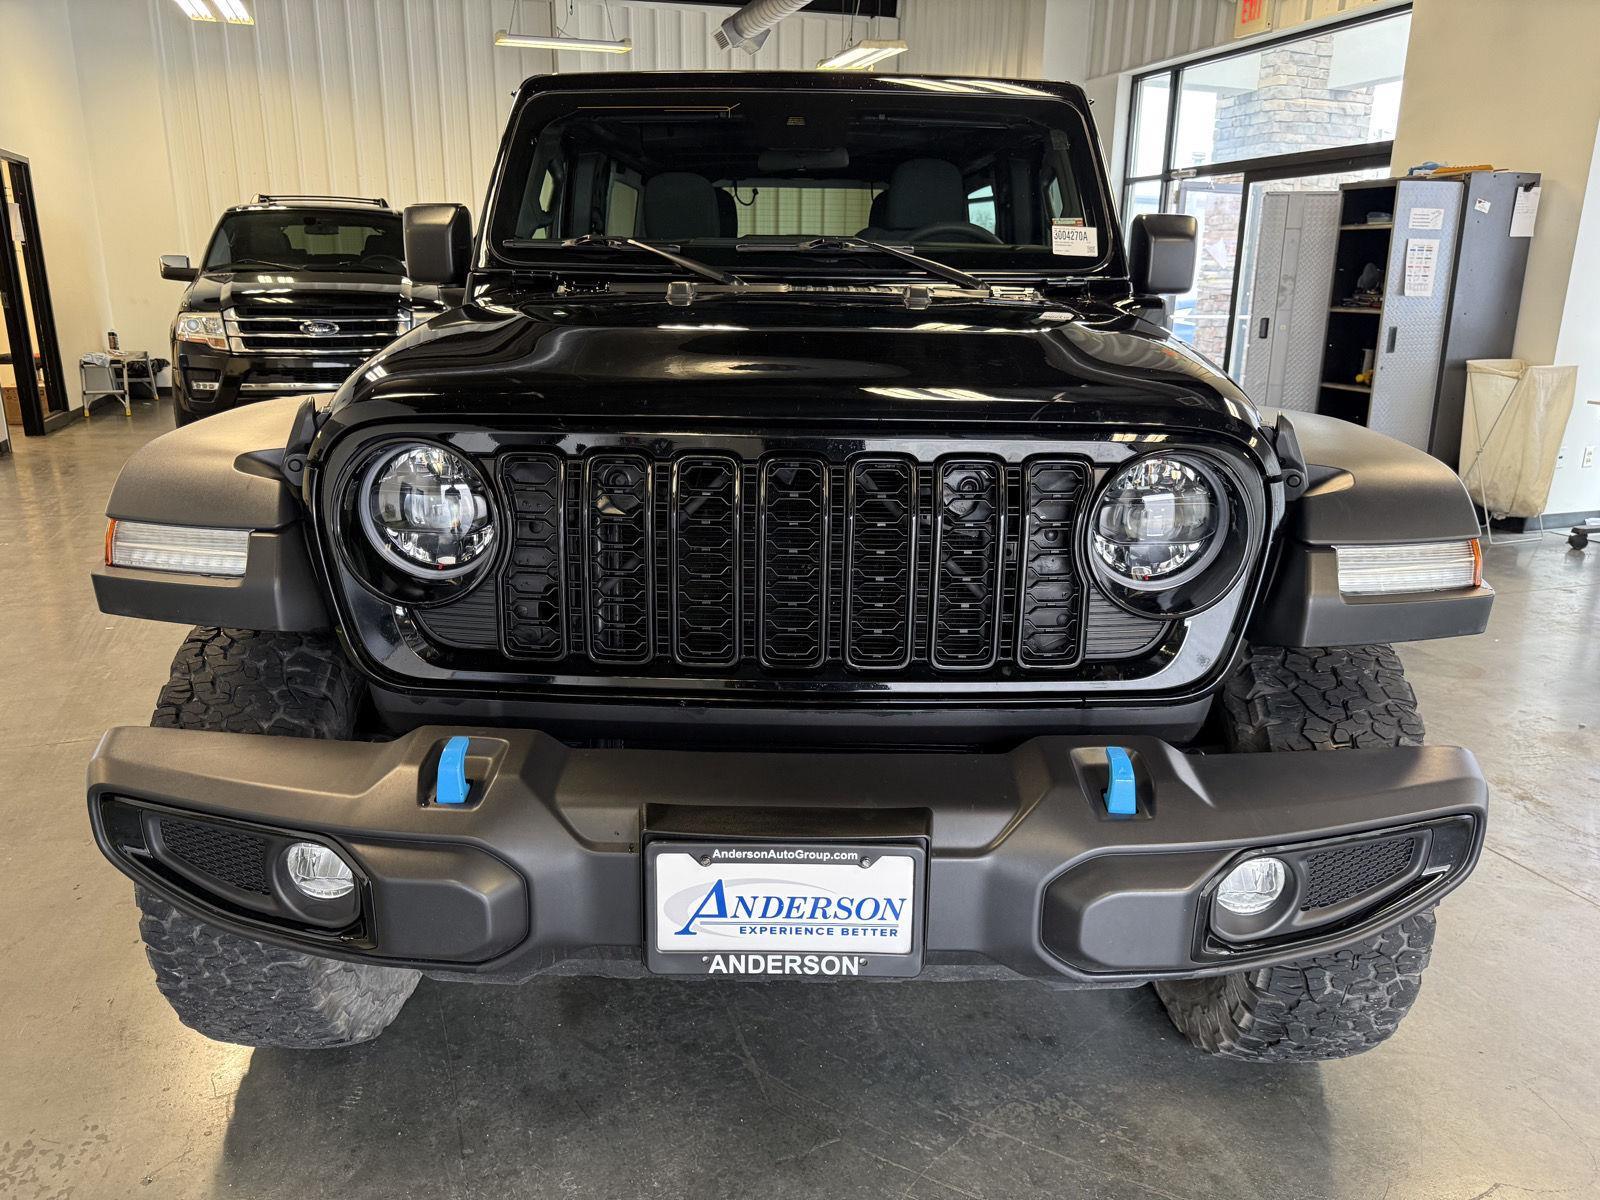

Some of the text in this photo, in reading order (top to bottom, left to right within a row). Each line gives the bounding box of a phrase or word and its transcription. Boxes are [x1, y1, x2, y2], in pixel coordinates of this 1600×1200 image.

[712, 849, 858, 861] AndersonAutoGroup.com
[674, 879, 907, 936] ANDERSON
[739, 926, 898, 937] EXPERIENCE BETTER
[708, 955, 860, 975] ANDERSON
